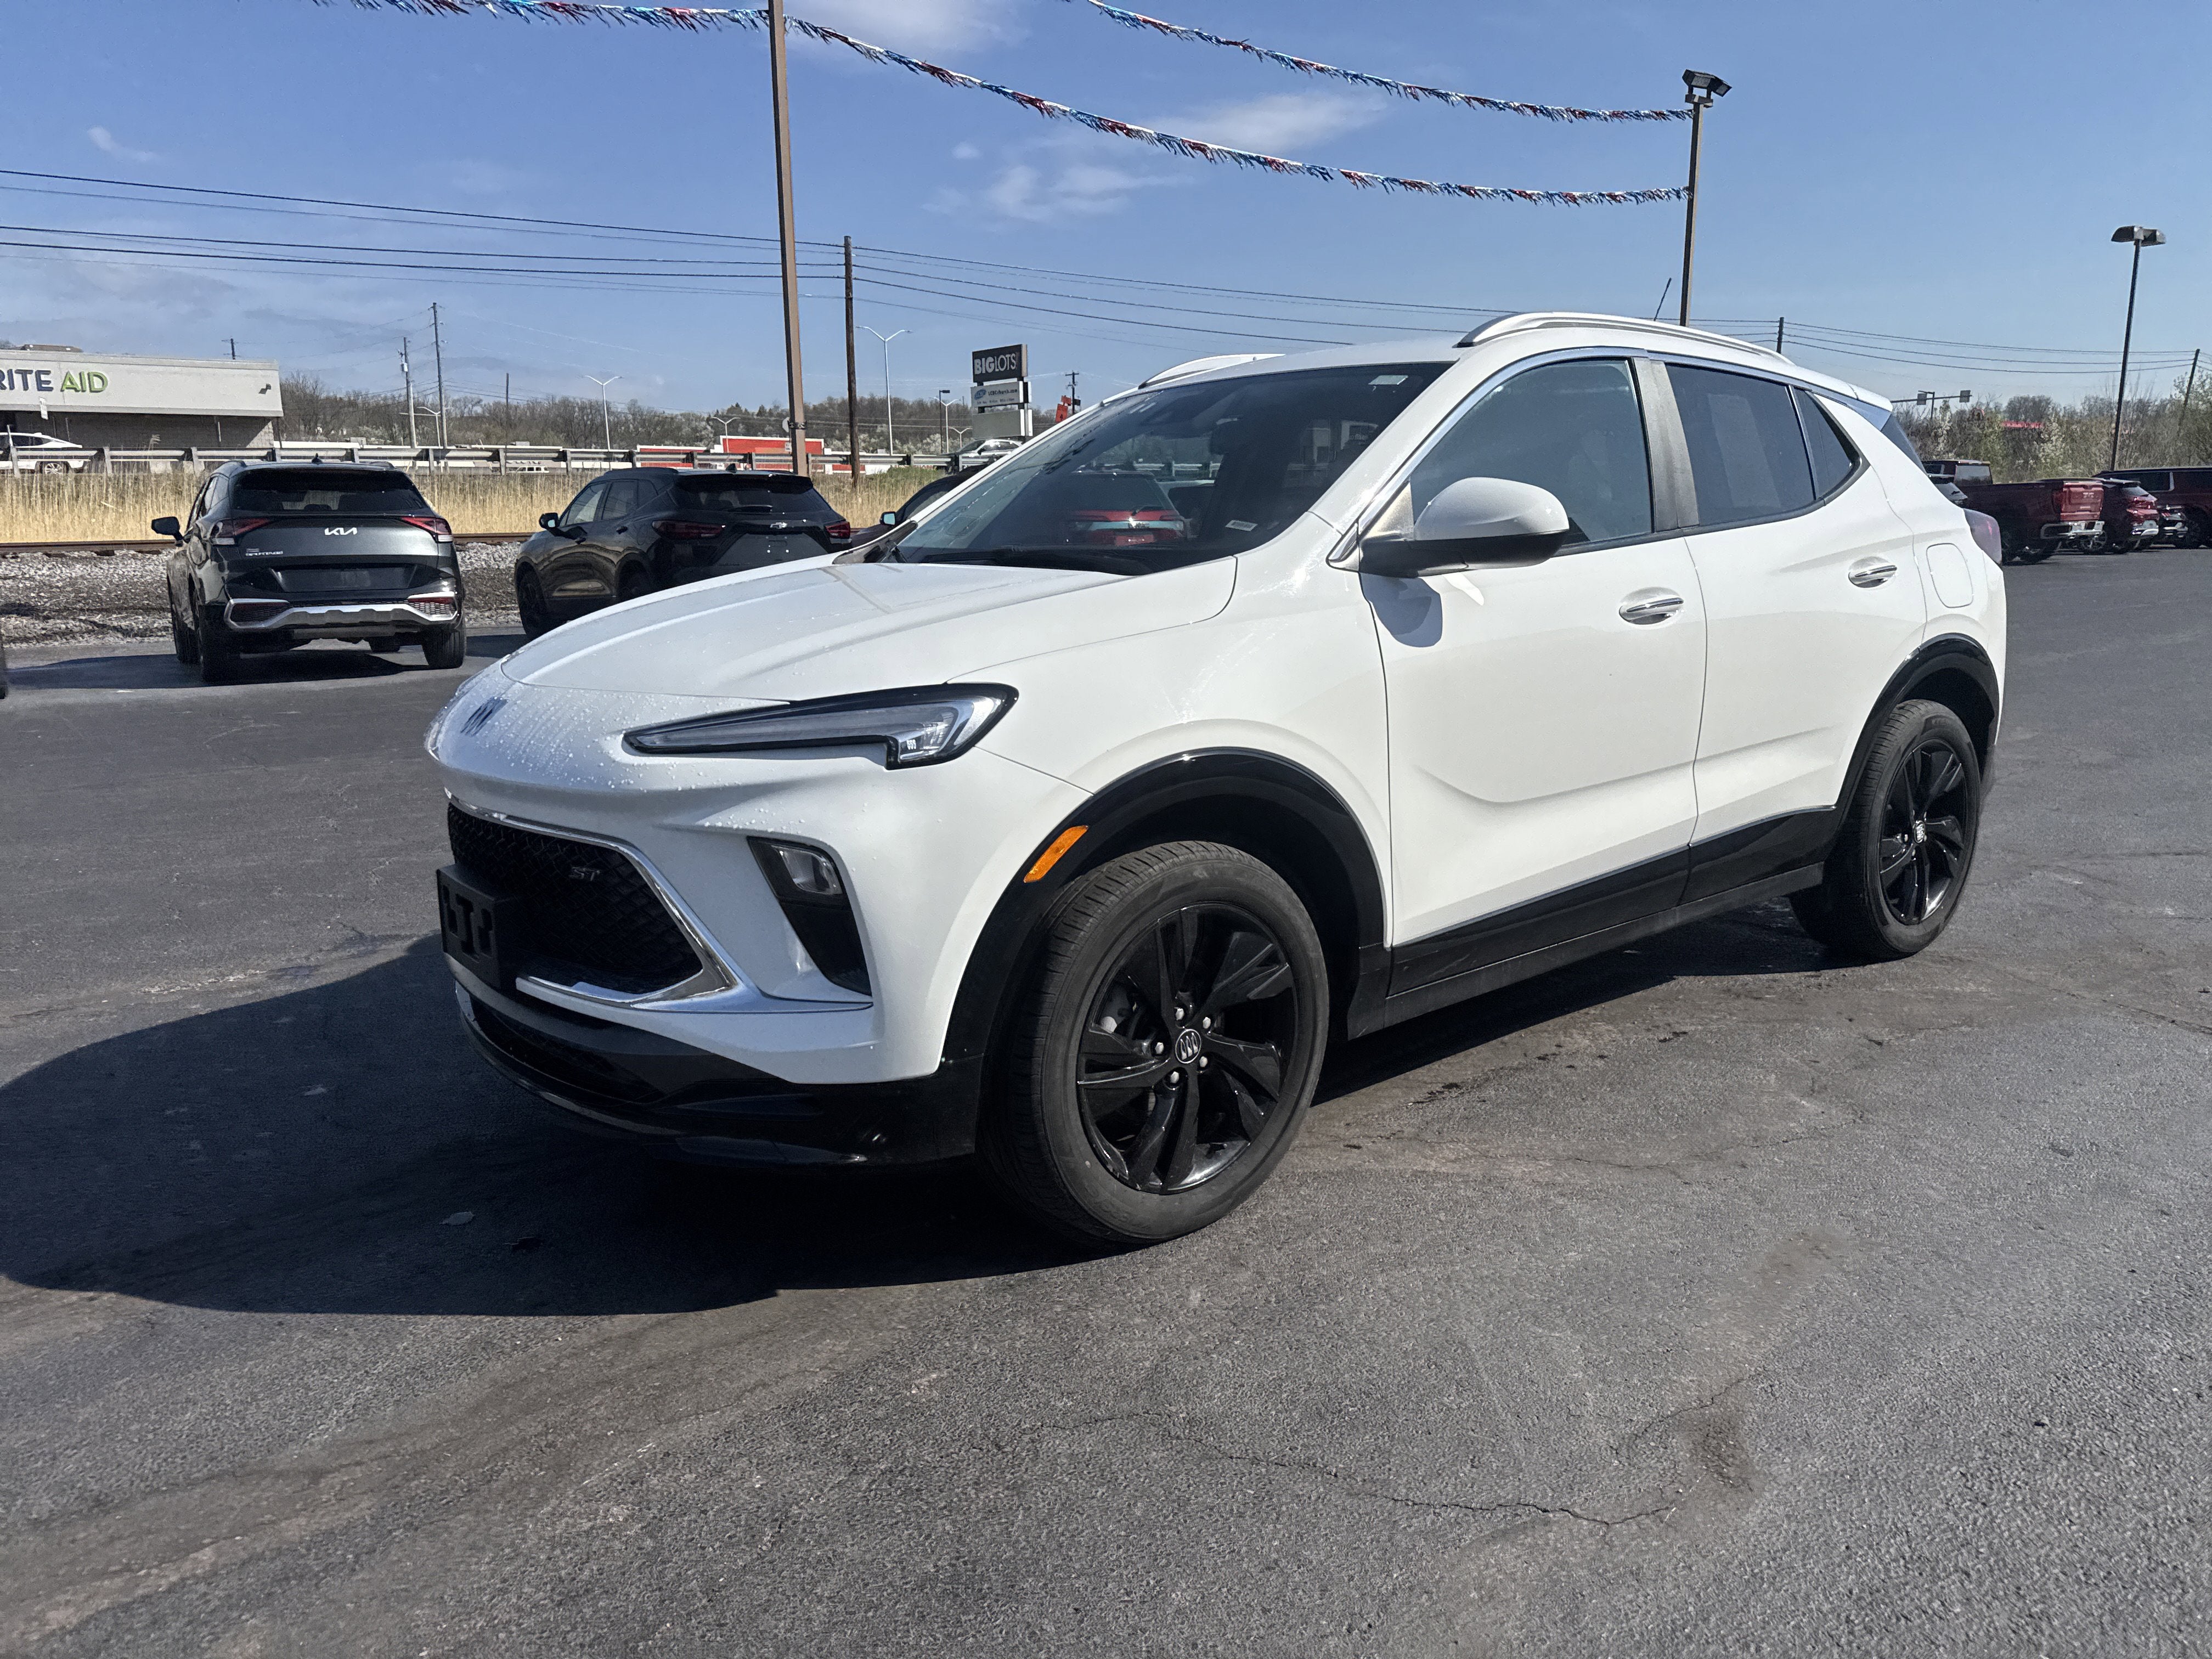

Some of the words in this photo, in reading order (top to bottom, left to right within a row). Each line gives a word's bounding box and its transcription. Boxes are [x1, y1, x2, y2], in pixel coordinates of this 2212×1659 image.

[0, 369, 54, 391] RITE
[60, 371, 109, 393] AID
[324, 527, 358, 535] KIA
[568, 867, 600, 882] ST
